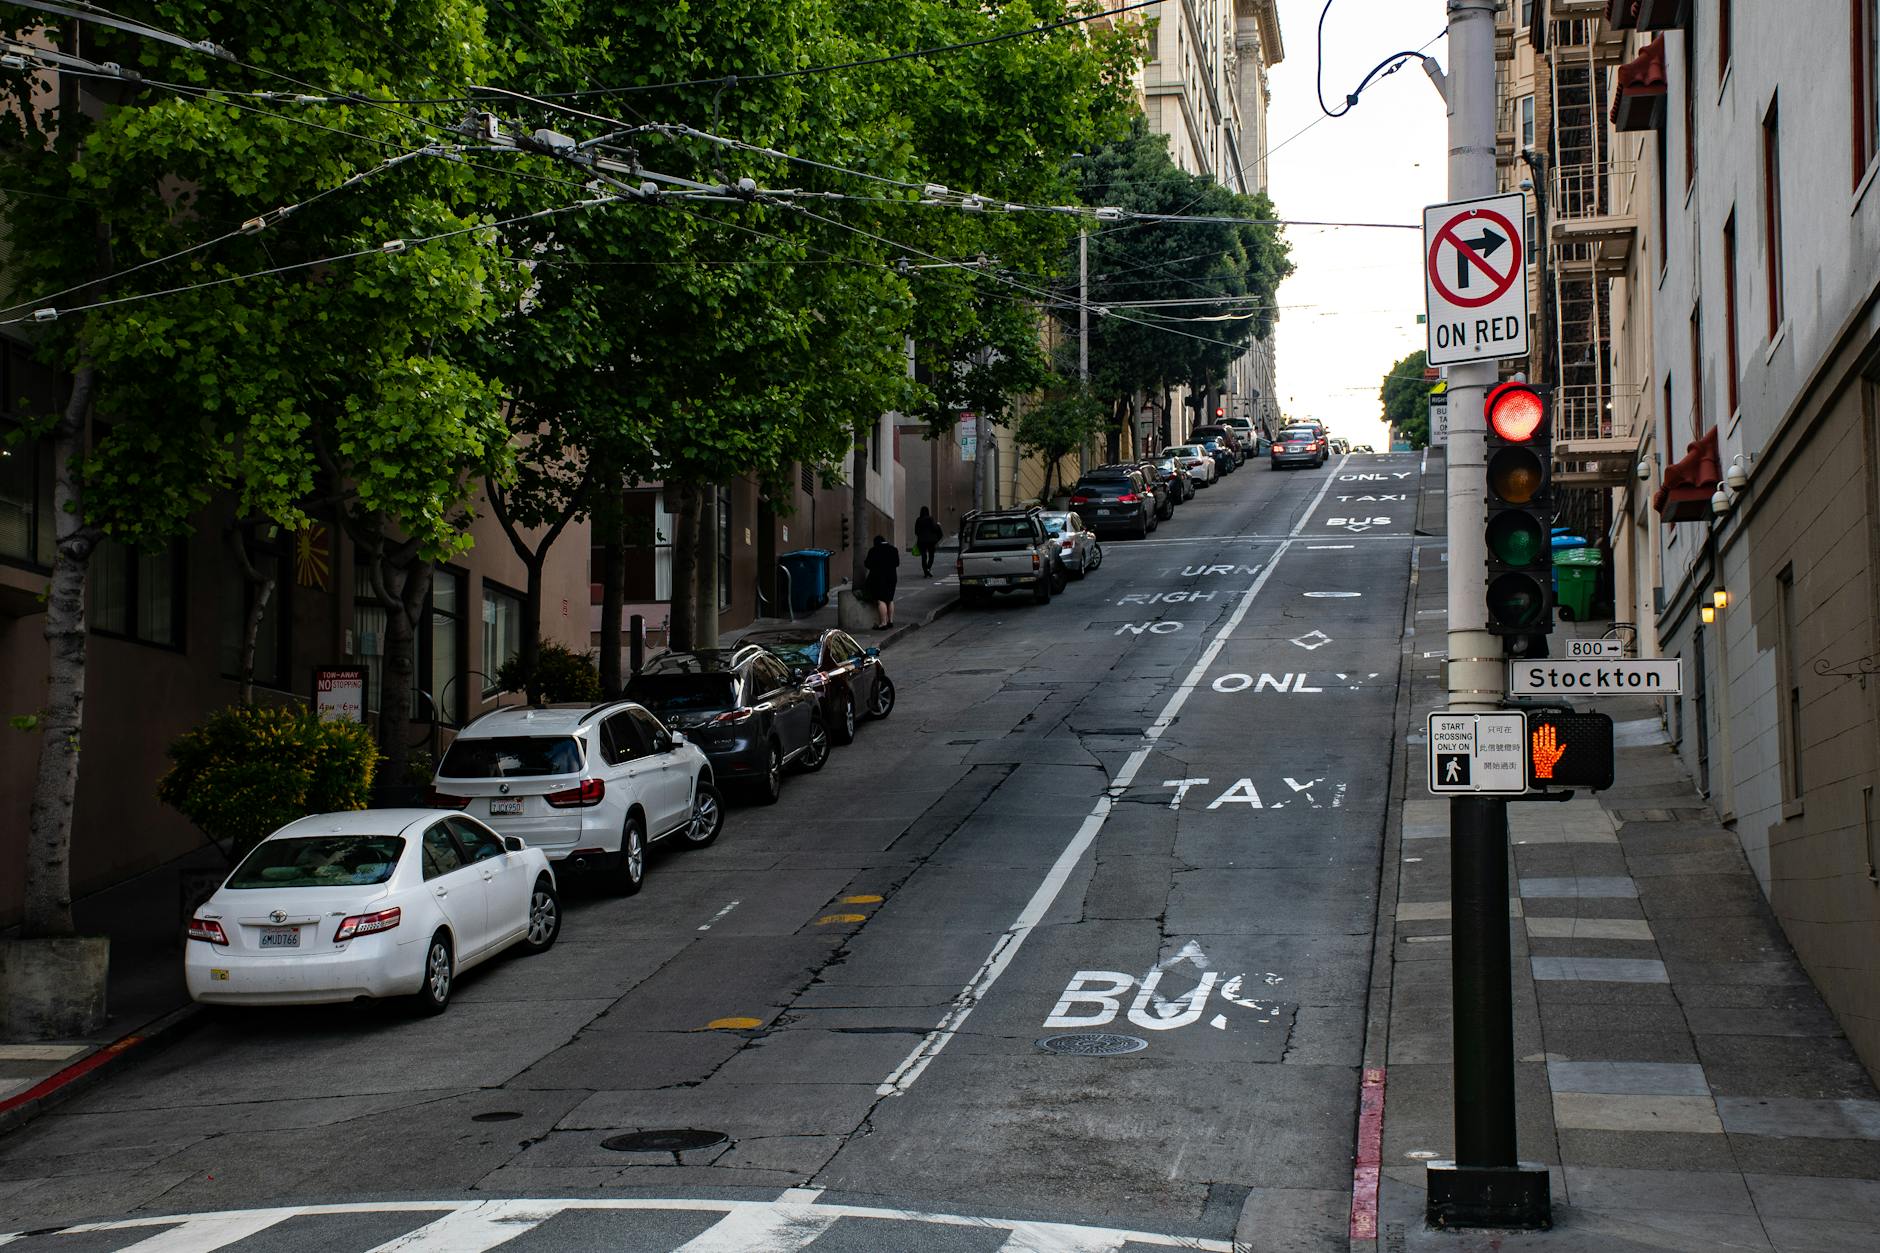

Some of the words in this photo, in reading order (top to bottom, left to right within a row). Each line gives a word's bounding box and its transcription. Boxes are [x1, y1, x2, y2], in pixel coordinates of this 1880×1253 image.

[1437, 322, 1465, 348] ON
[1476, 316, 1519, 343] RED
[1339, 472, 1412, 481] ONLY
[1336, 494, 1406, 502] TAXI
[1326, 516, 1392, 526] BUS
[1114, 621, 1184, 636] NO
[1572, 642, 1602, 655] 800
[1529, 668, 1660, 687] Stockton
[318, 679, 331, 690] NO
[332, 680, 361, 688] STOPPING
[262, 934, 298, 945] 6MUD766
